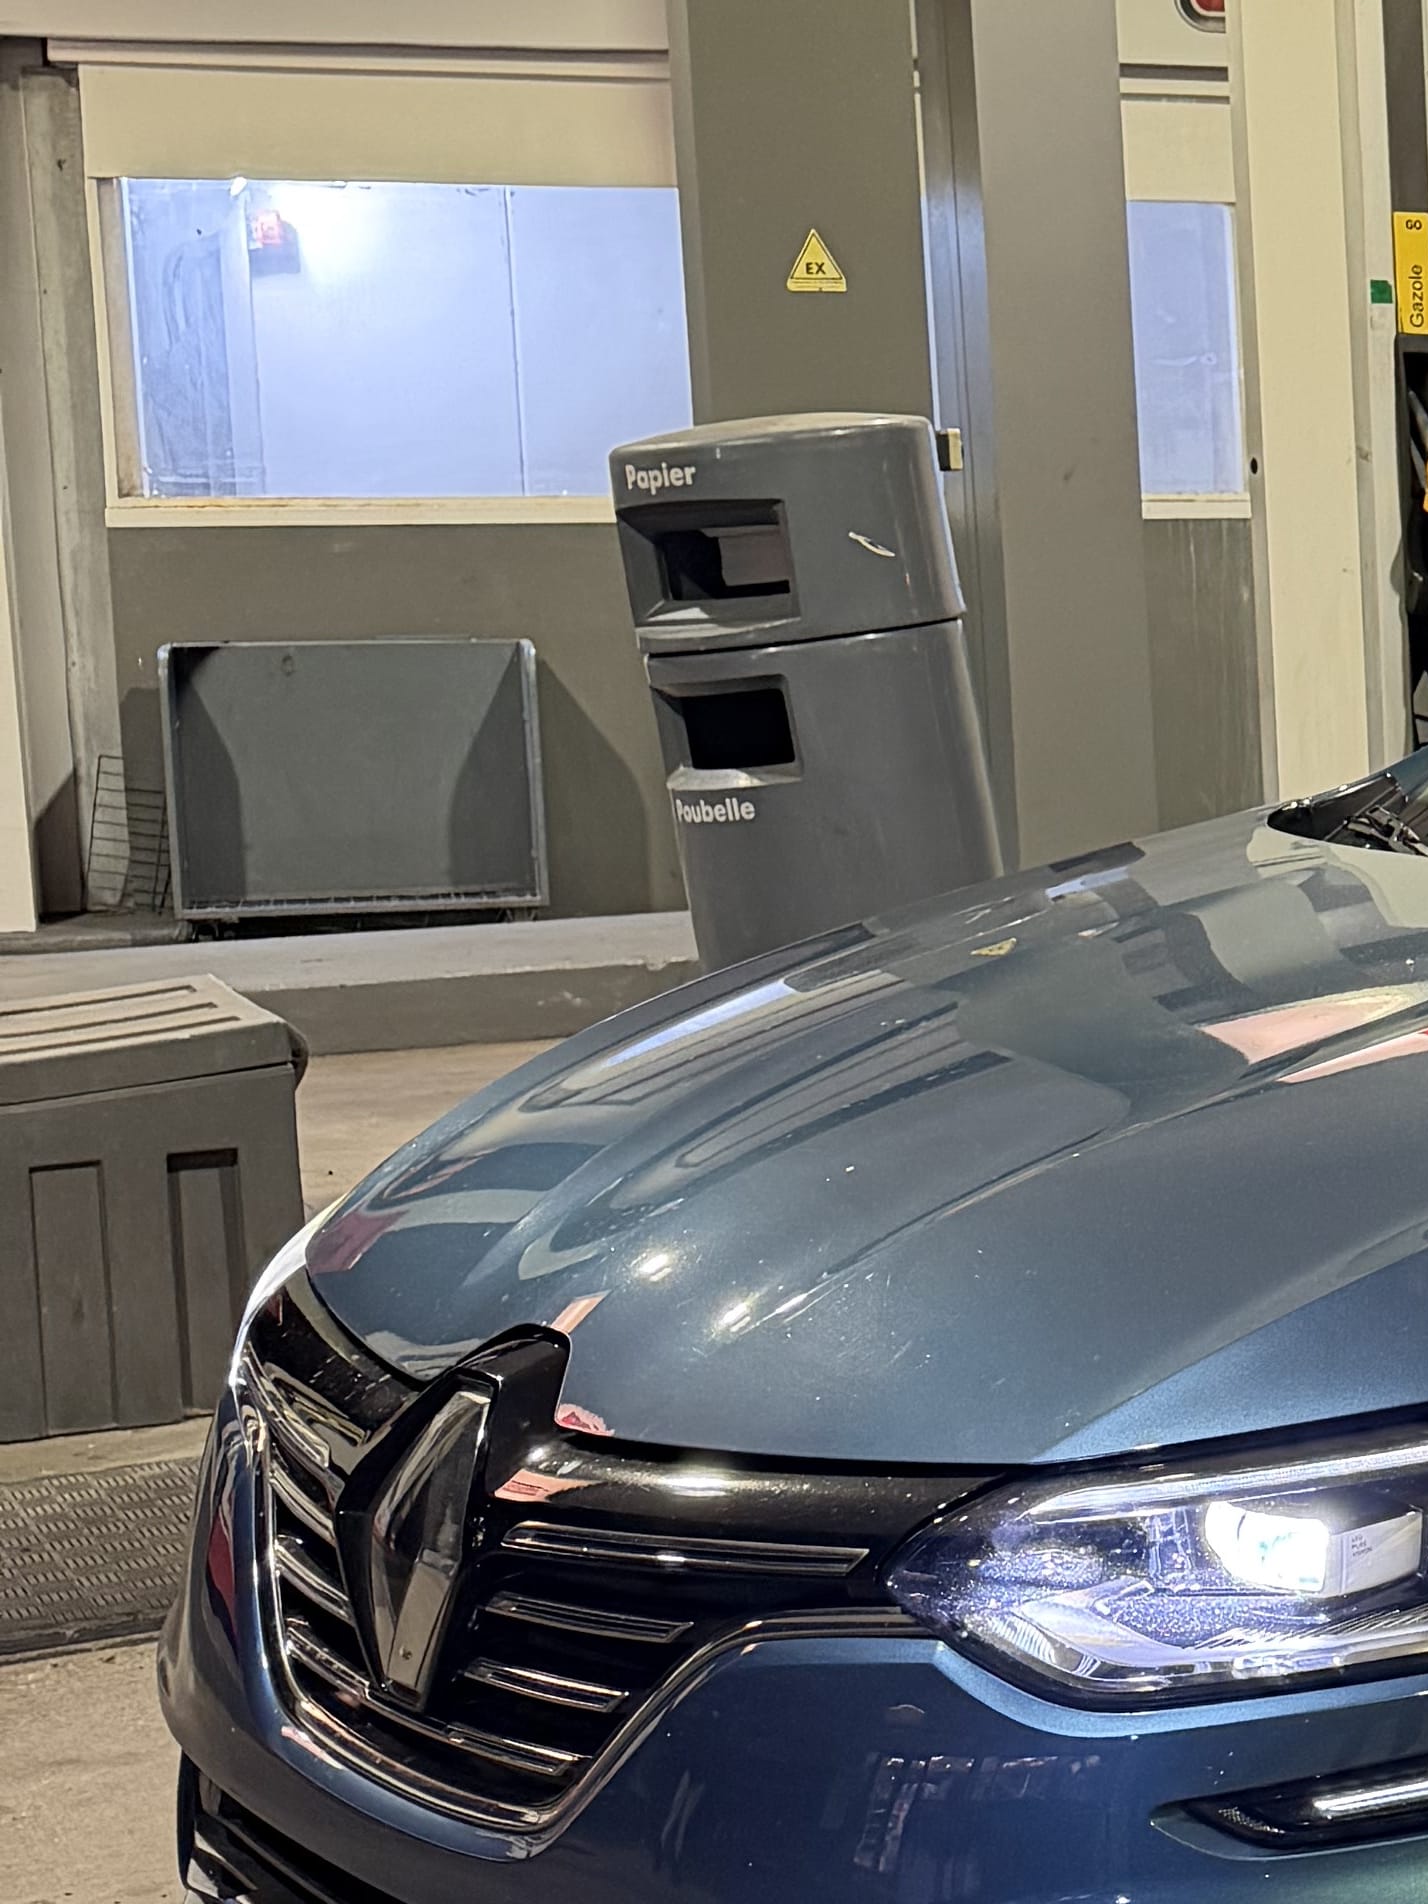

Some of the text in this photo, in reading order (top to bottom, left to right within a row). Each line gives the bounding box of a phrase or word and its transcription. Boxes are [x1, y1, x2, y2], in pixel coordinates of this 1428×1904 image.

[805, 262, 826, 275] EX
[1409, 264, 1423, 328] Gazole
[624, 462, 697, 496] Papier
[675, 797, 756, 823] Poubelle
